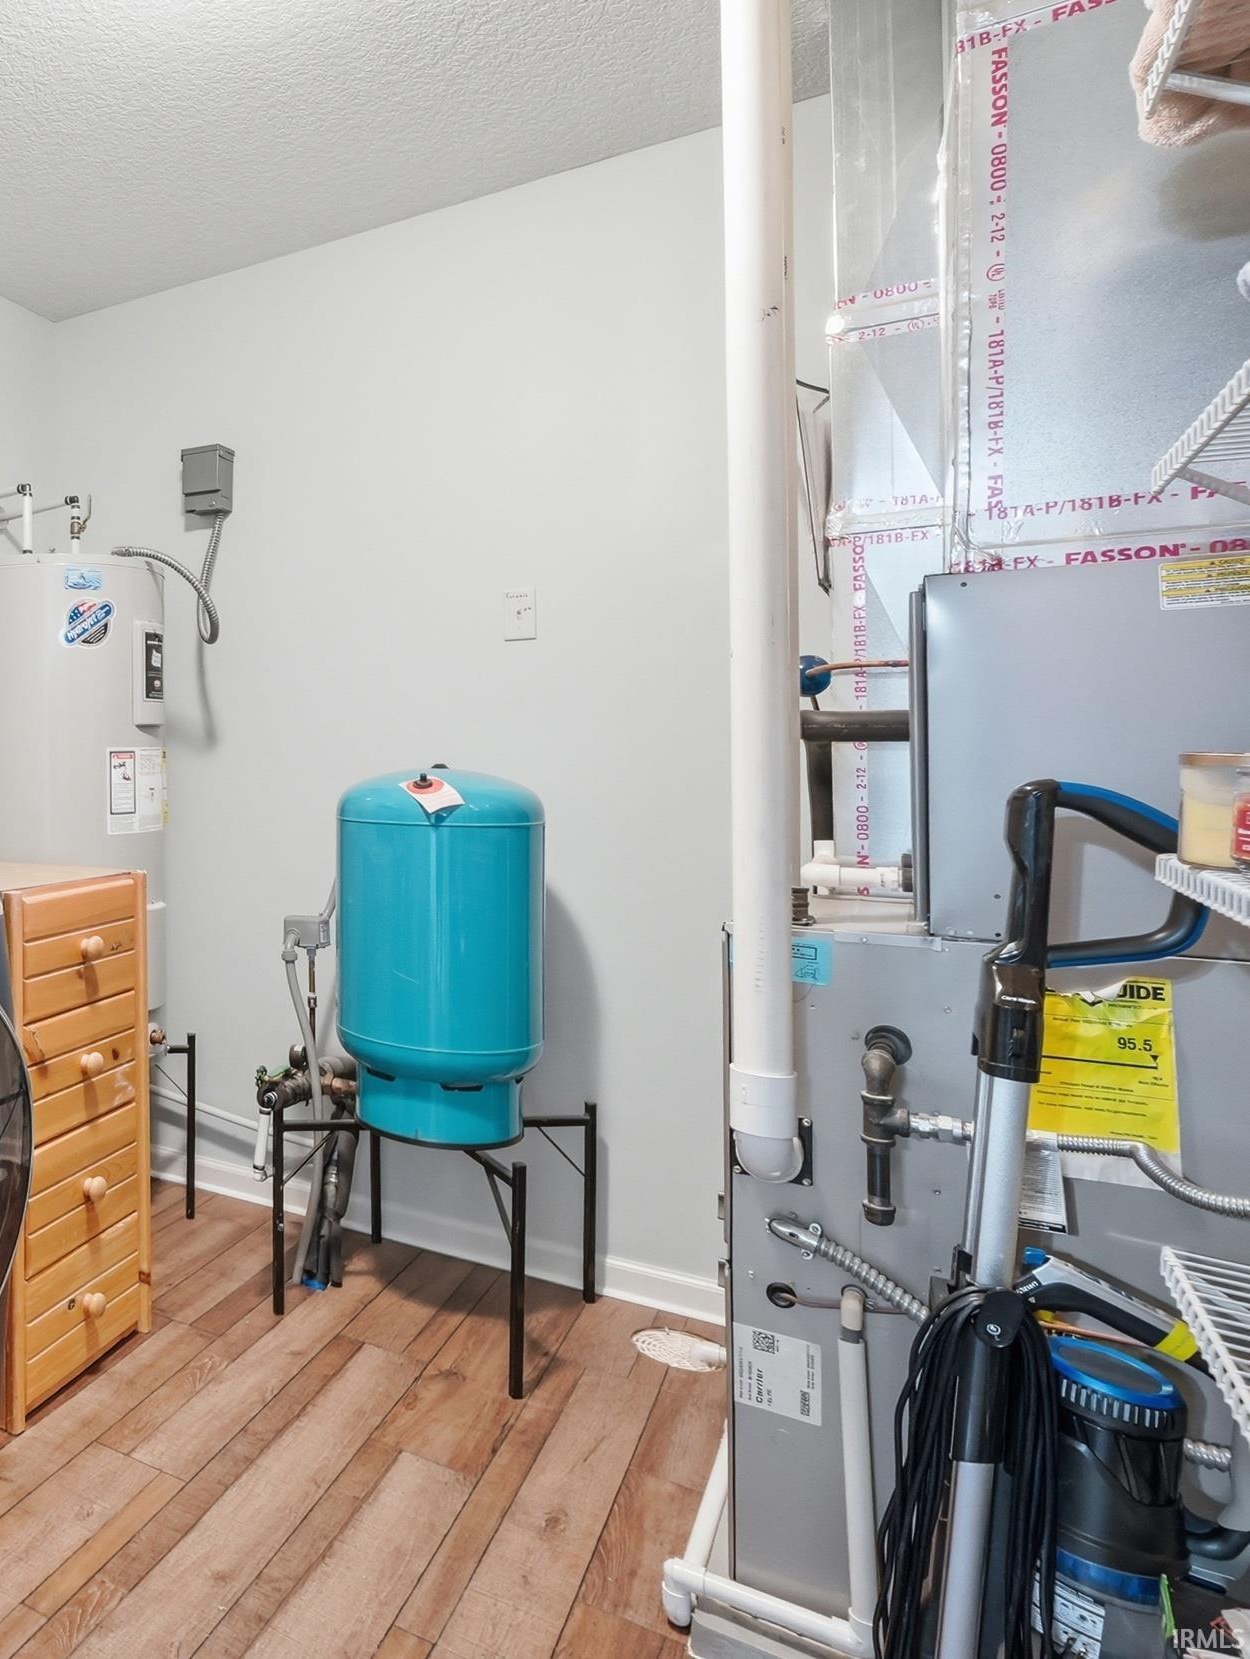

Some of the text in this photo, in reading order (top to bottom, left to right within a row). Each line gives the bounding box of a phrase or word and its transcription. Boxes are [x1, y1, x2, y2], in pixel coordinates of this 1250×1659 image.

[990, 143, 1007, 191] 0800
[990, 212, 1006, 243] 2-12
[853, 606, 868, 701] 181A-/181B-FX
[856, 768, 867, 790] 2-12
[856, 805, 869, 841] 0800
[1117, 1036, 1153, 1052] 95.5
